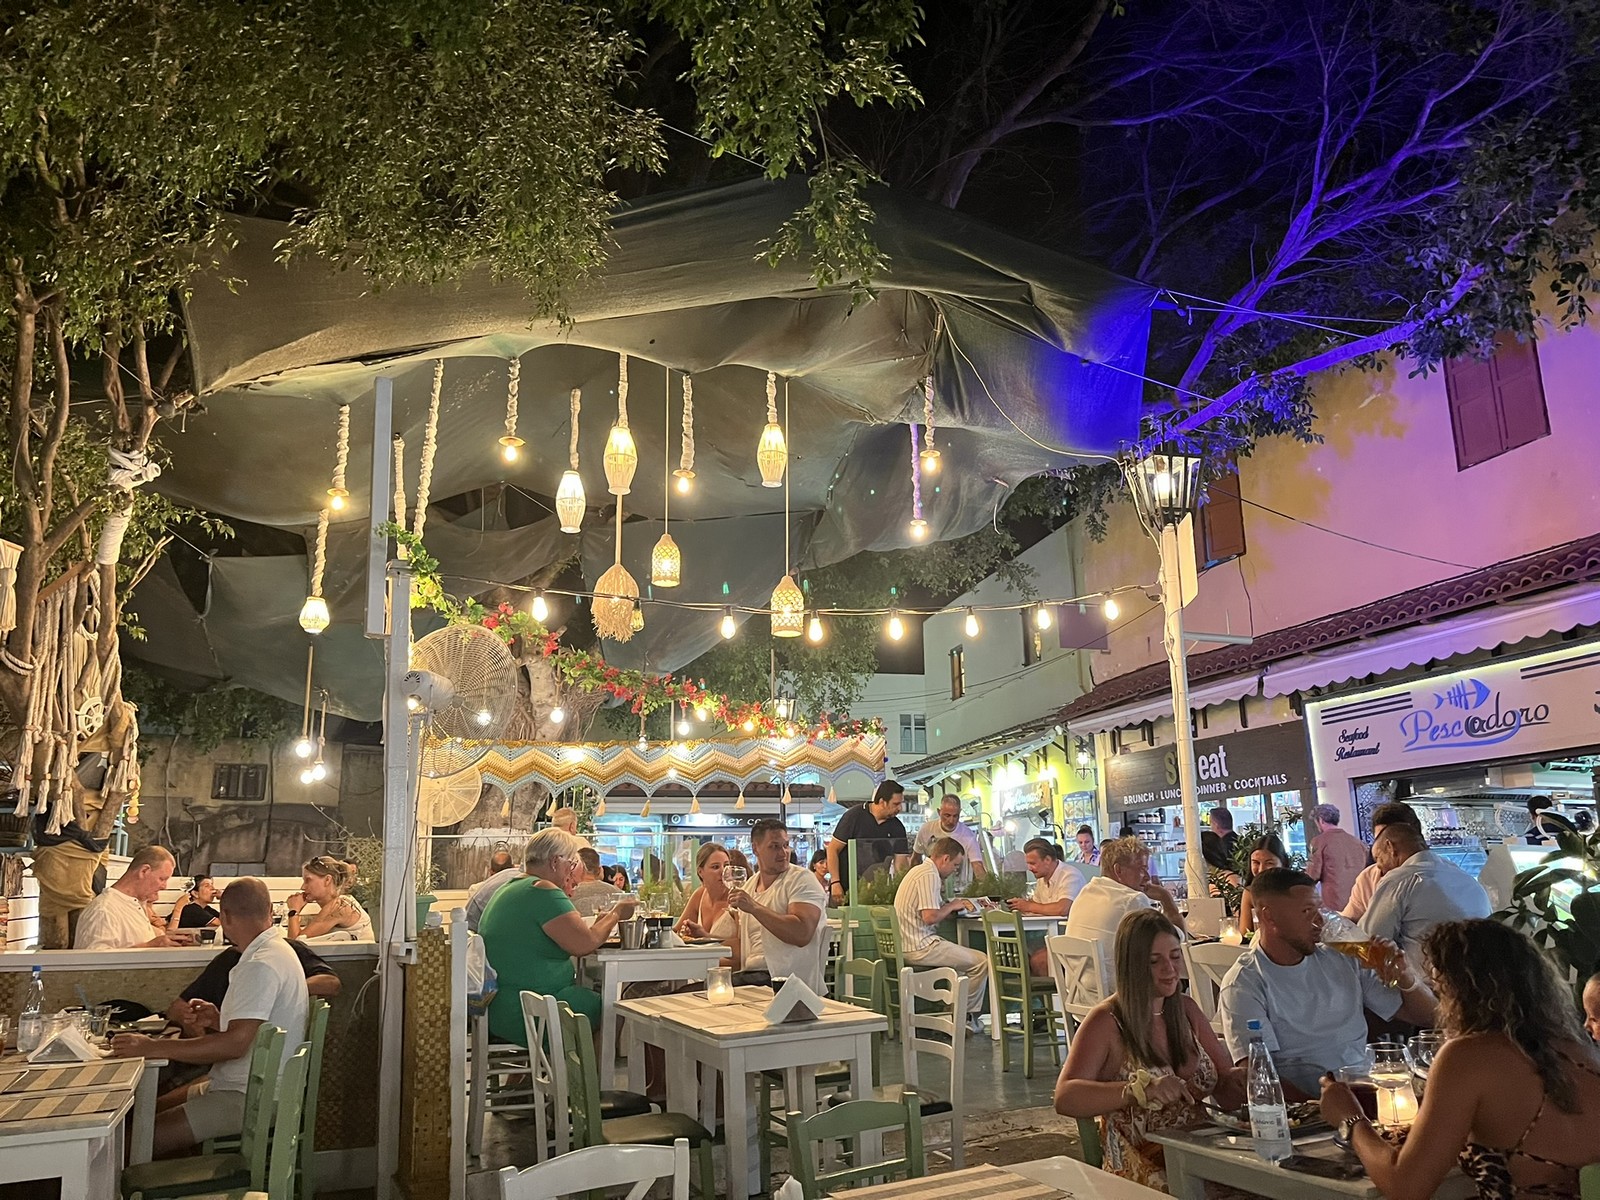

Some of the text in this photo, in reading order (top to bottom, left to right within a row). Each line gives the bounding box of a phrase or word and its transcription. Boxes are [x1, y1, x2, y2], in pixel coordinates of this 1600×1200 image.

[1400, 691, 1550, 749] Pescadoro
[1338, 725, 1369, 745] Seafood
[1334, 742, 1380, 762] Restaurant
[1123, 792, 1155, 805] BRUNCH
[1161, 787, 1183, 801] LUNC
[1233, 773, 1288, 790] COCKTAILS
